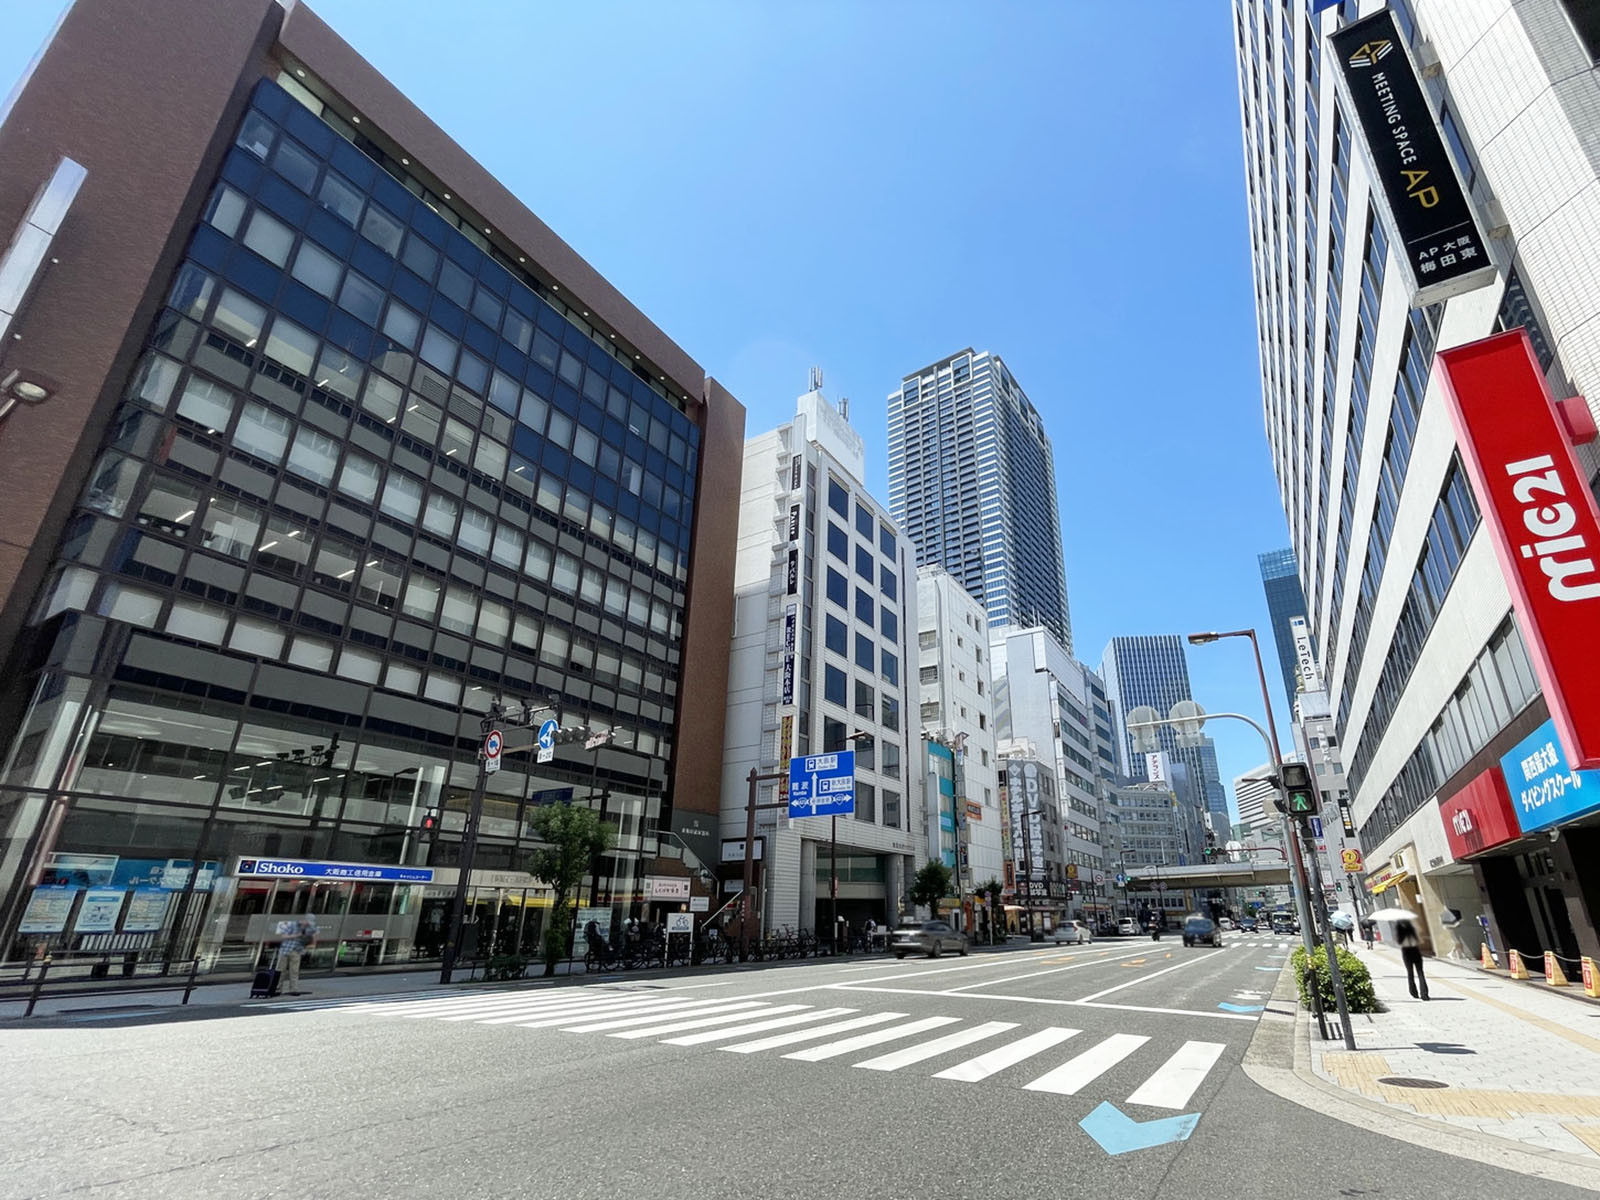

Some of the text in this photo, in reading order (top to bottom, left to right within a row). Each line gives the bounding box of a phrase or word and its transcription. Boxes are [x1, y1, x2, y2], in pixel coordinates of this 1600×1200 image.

[1371, 71, 1441, 210] MEETING SPACE AP
[1419, 234, 1472, 261] AP 大阪
[1420, 246, 1478, 274] 梅田東
[1505, 454, 1600, 603] mic21
[1296, 636, 1315, 680] LeTech
[817, 756, 837, 765] 大阪駅
[1520, 741, 1560, 783] 関西最大級
[1520, 770, 1582, 813] ダイビングスクール
[258, 862, 304, 874] Shoko
